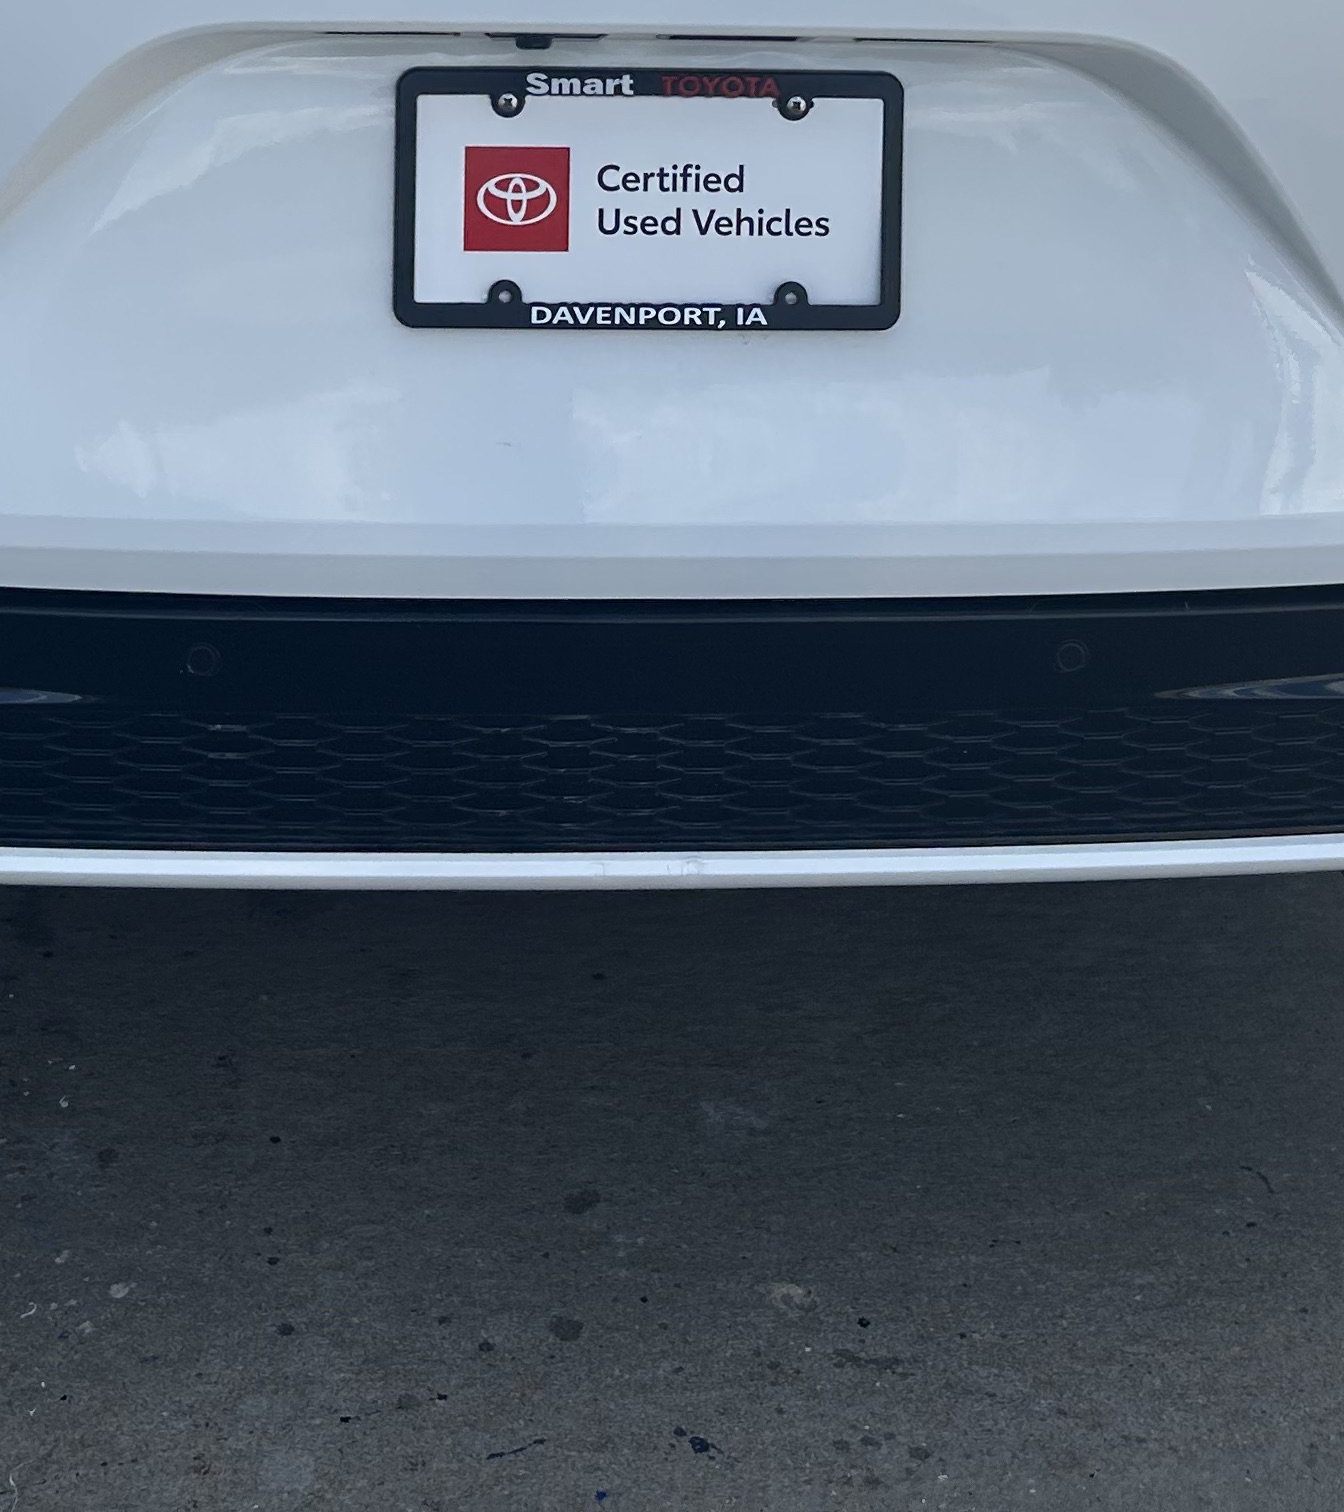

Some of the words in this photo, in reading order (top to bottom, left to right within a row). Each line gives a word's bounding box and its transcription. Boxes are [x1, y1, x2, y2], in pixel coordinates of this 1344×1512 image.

[525, 72, 635, 96] Smart
[661, 75, 781, 98] TOYOTA
[596, 163, 745, 193] Certified
[597, 207, 682, 236] Used
[691, 207, 831, 237] Vehicles
[530, 305, 726, 329] DAVENPORT,
[736, 306, 768, 326] IA
